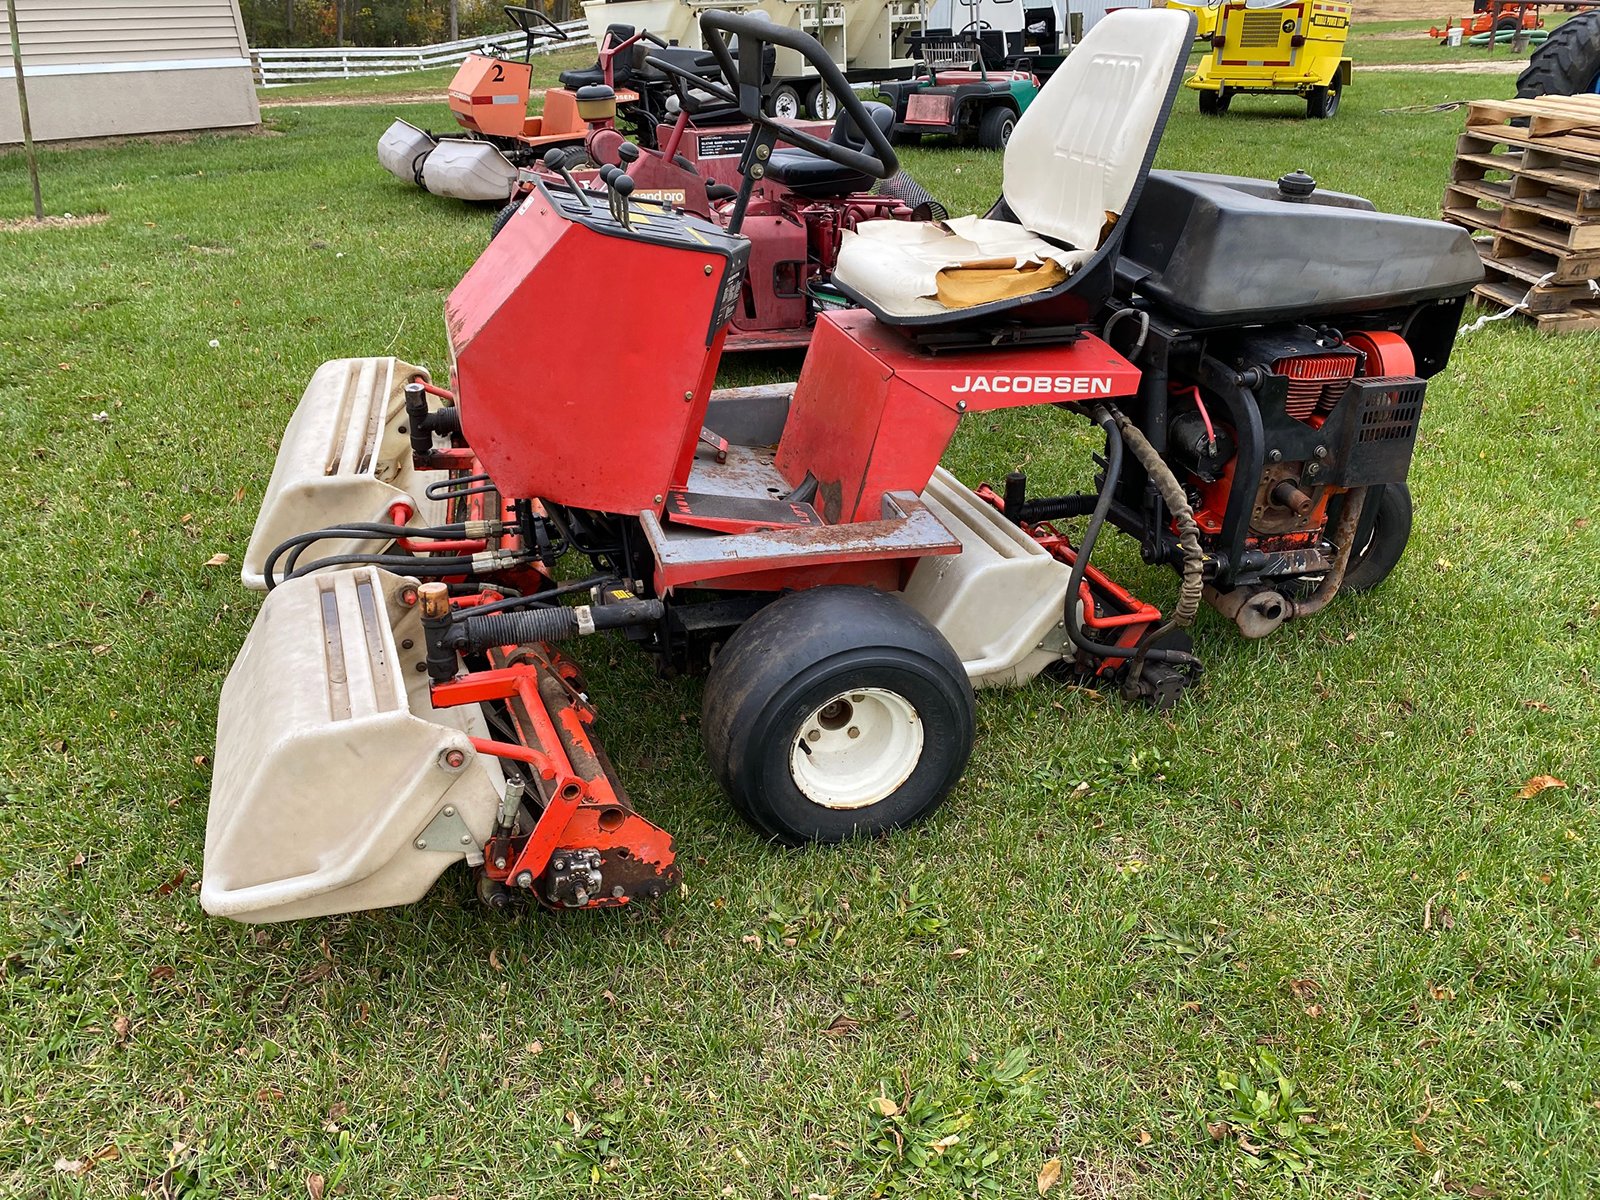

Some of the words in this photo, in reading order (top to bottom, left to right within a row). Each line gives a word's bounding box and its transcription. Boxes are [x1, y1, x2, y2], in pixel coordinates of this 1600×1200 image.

[492, 64, 505, 82] 2
[664, 192, 684, 204] pro
[951, 376, 1112, 394] JACOBSEN
